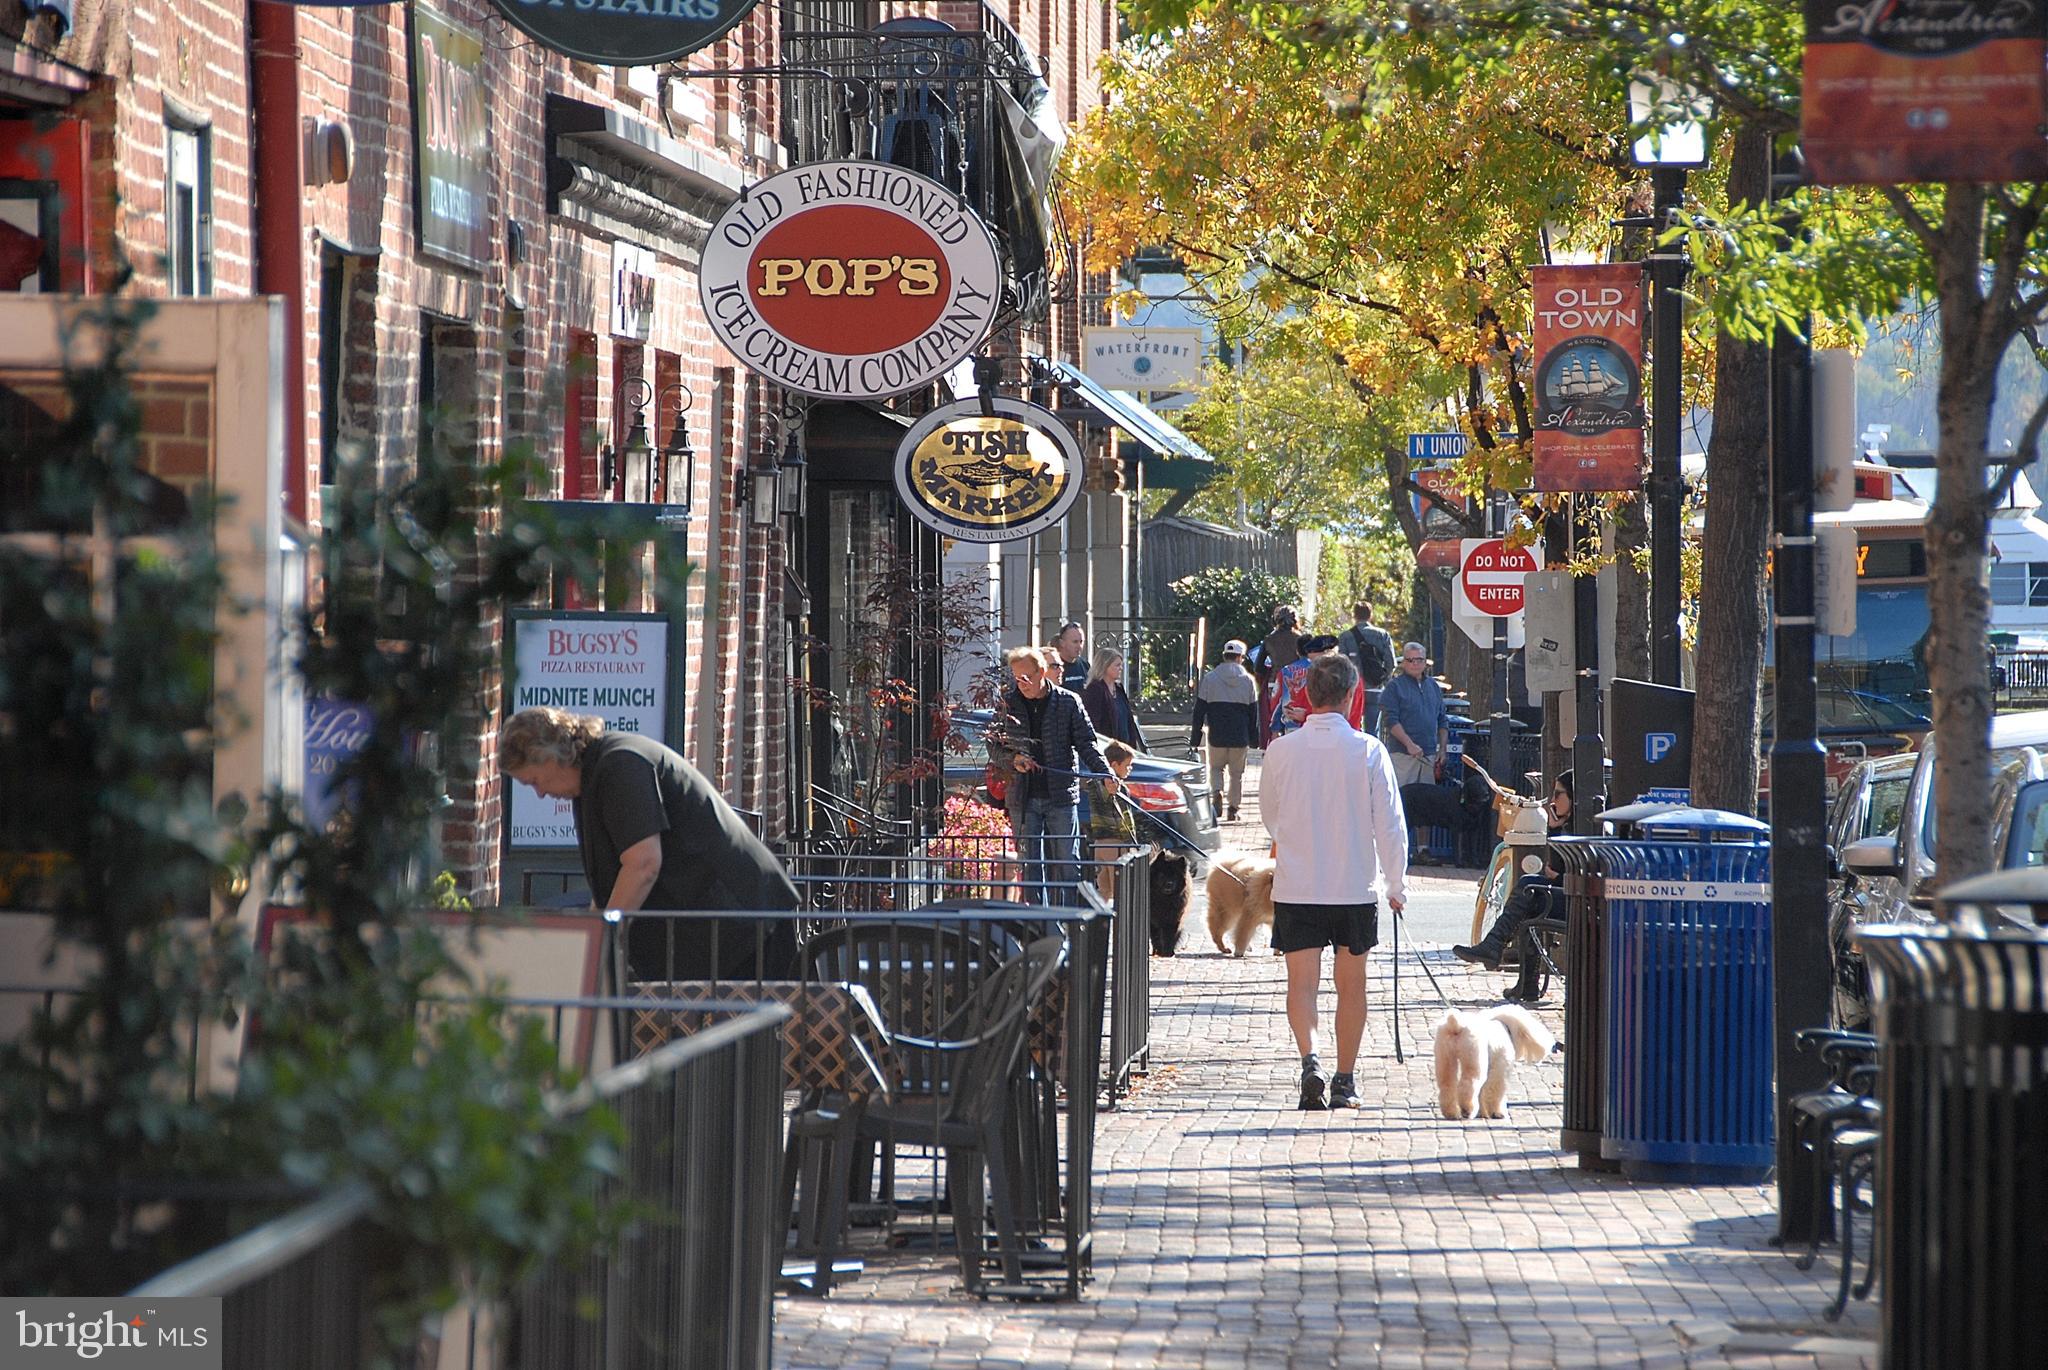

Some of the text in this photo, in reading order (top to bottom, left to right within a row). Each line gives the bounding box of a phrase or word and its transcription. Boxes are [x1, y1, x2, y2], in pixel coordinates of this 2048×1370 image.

[723, 167, 969, 249] OLD FASHIONED
[757, 255, 940, 297] POP'S
[1555, 288, 1623, 307] OLD
[1539, 309, 1637, 329] TOWN
[709, 279, 756, 340] ICE
[744, 327, 853, 394] CREAM
[858, 276, 992, 394] COMPANY
[1568, 338, 1608, 347] WELCOME
[1095, 344, 1189, 357] WATERFRONT
[942, 430, 1030, 464] FISH
[1416, 437, 1424, 455] N
[919, 457, 1055, 516] MARKET
[951, 526, 1032, 541] RESTAURANT
[1475, 555, 1526, 567] DO NOT
[1479, 588, 1520, 601] ENTER
[548, 629, 638, 656] BUGSY'S
[540, 661, 645, 674] PIZZA RESTAURANT
[520, 687, 655, 707] MIDNITE MUNCH
[604, 716, 639, 732] n-Eat
[512, 825, 557, 838] BUGSY'S
[1607, 885, 1686, 896] CYCLING ONLY
